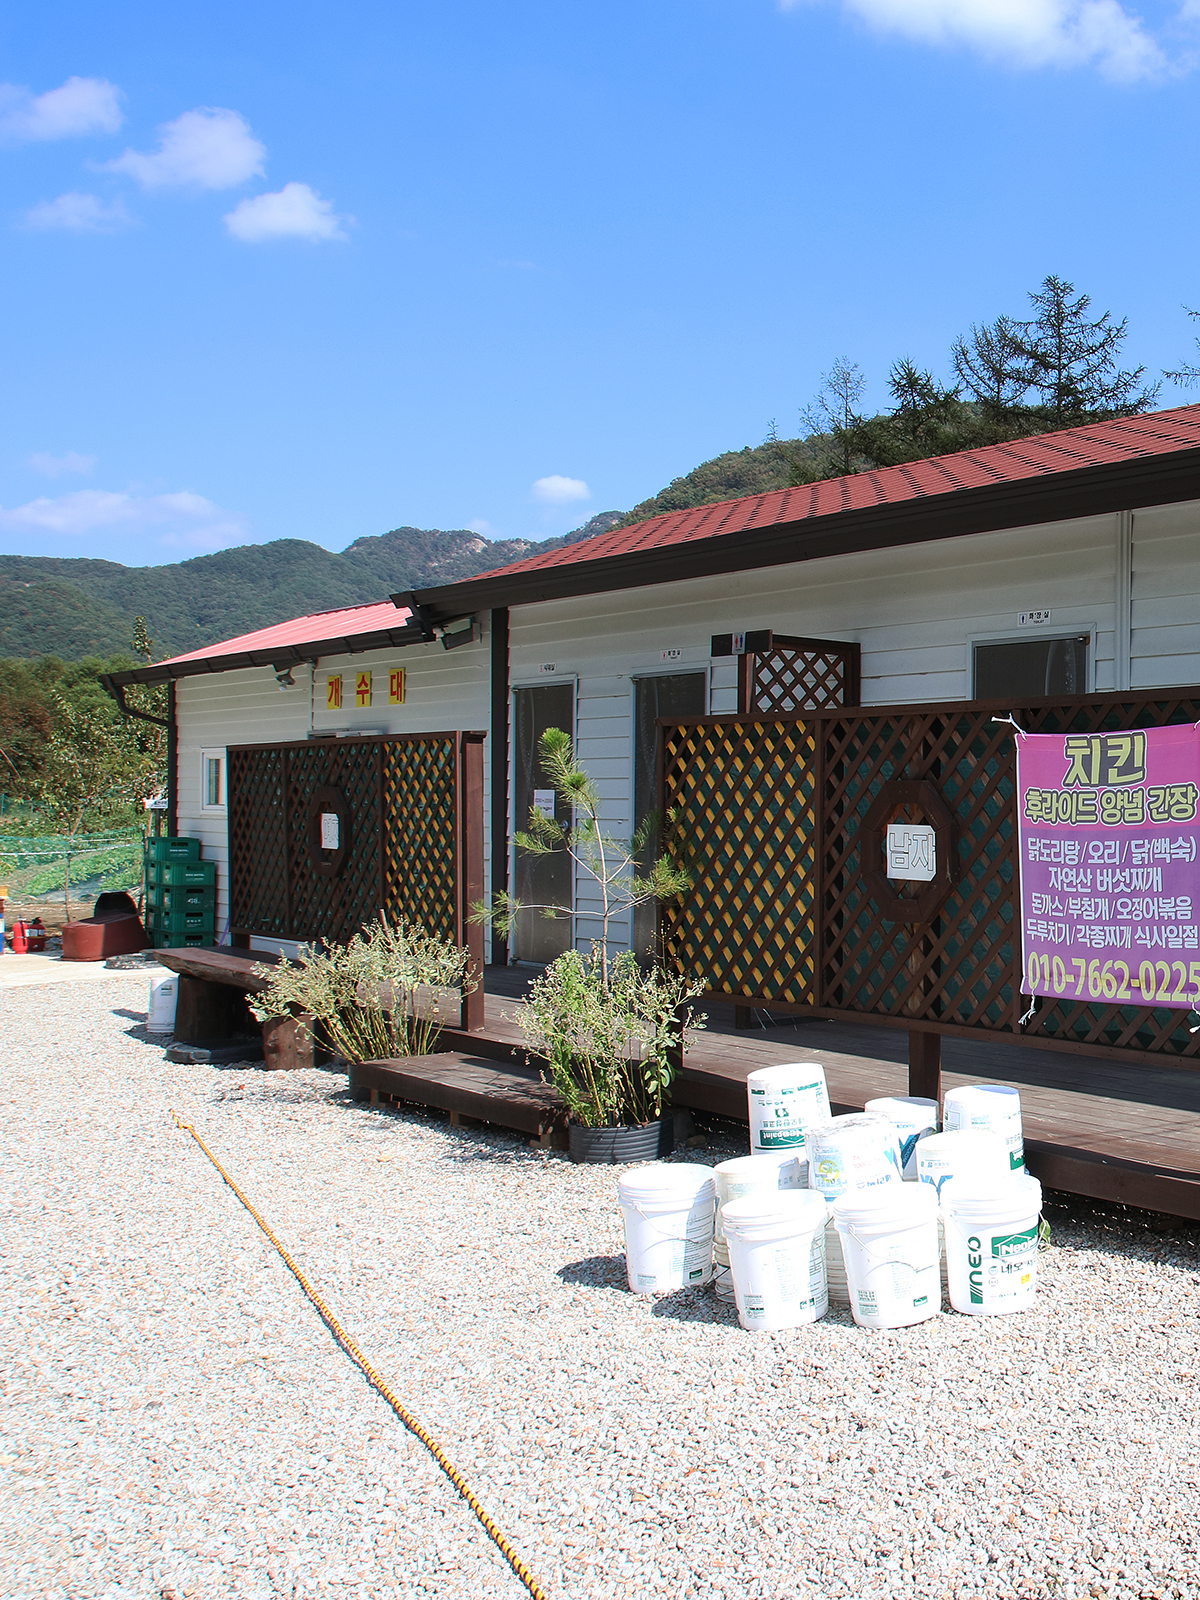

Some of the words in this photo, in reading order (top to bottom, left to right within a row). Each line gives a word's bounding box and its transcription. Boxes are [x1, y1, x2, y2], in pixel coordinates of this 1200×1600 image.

[1063, 733, 1145, 786] 치킨
[1026, 788, 1098, 823] 후라이드
[1101, 789, 1144, 823] 양념
[1149, 785, 1197, 820] 간장
[889, 832, 935, 871] 남자
[1048, 866, 1093, 893] 자연산
[1096, 866, 1163, 893] 버섯찌개
[1134, 924, 1199, 949] 식사일절
